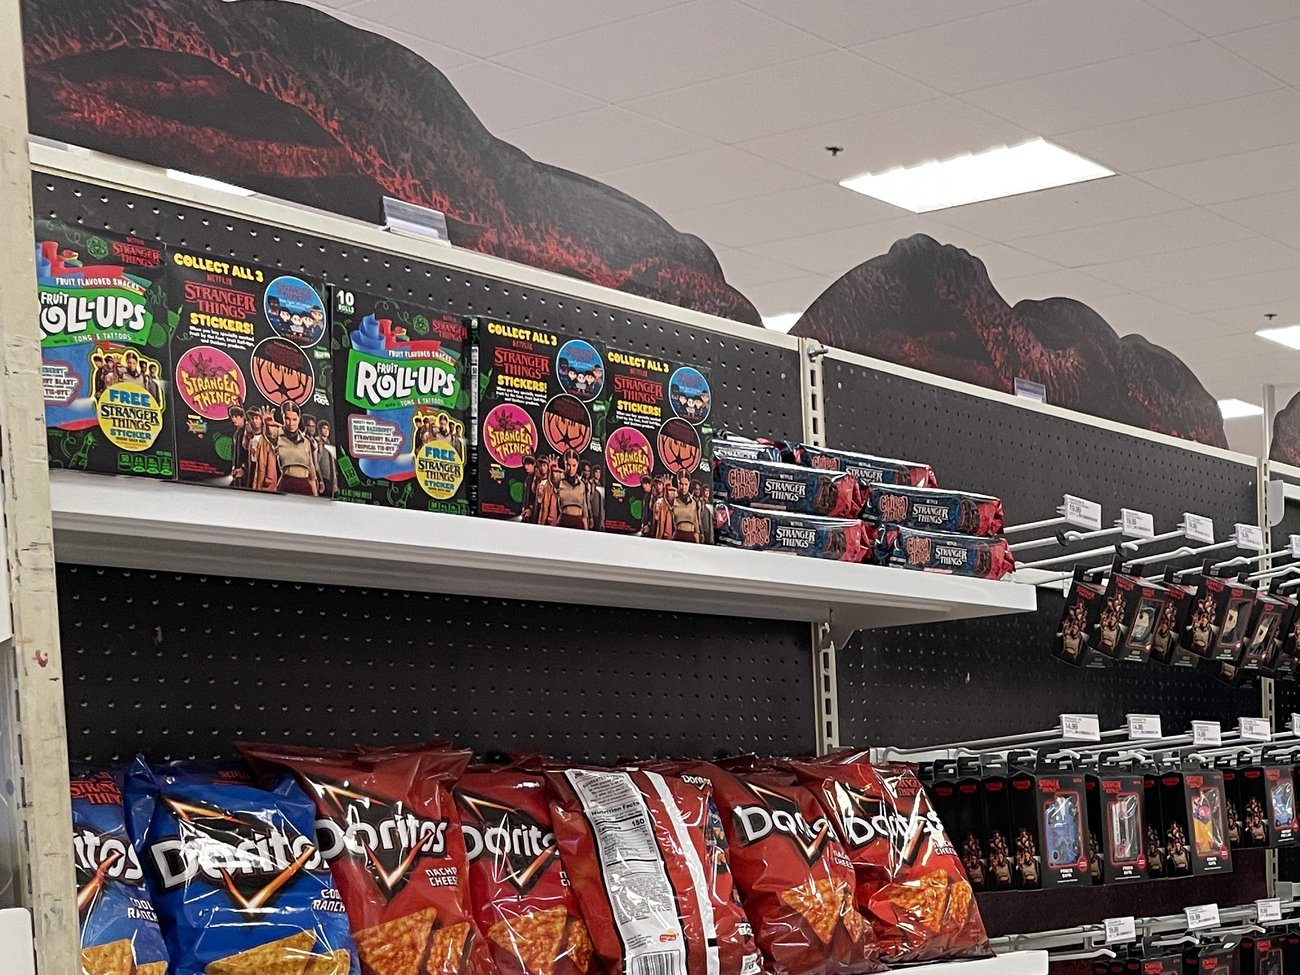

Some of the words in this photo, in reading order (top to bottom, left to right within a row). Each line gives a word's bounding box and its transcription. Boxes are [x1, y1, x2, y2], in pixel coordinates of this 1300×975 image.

[173, 253, 230, 275] COLLECT
[232, 266, 254, 281] ALL
[256, 270, 264, 283] 3
[56, 277, 75, 286] FRUIT
[78, 277, 112, 287] FLAVORED
[113, 277, 140, 291] SNACKS
[41, 292, 70, 305] FRUIT
[184, 282, 257, 314] STRANGER
[336, 290, 355, 306] 10
[197, 302, 246, 320] THINGS
[190, 313, 254, 335] STICKERS!
[488, 323, 531, 340] COLLECT
[533, 332, 549, 345] ALL
[551, 336, 558, 346] 3
[377, 362, 398, 374] FRUIT
[495, 348, 550, 374] STRANGER
[608, 352, 646, 369] COLLECT
[647, 361, 662, 373] ALL
[663, 363, 670, 373] 3
[503, 363, 541, 379] THINGS
[181, 369, 240, 396] STRANGER
[356, 361, 455, 404] ROLL-UPS
[498, 375, 547, 393] STICKERS!
[614, 375, 663, 399] STRANGER
[109, 389, 150, 407] FREE
[194, 391, 238, 410] THINGS
[623, 389, 656, 404] THINGS
[101, 403, 159, 426] STRANGER
[617, 400, 661, 417] STICKERS!
[111, 418, 151, 431] THINGS
[110, 429, 151, 440] STICKER
[425, 447, 456, 461] FREE
[419, 460, 460, 477] STRANGER
[426, 470, 455, 482] THINGS
[765, 480, 806, 496] STRANGER
[771, 490, 799, 502] THINGS
[912, 504, 949, 520] STRANGER
[917, 514, 943, 524] THINGS
[776, 527, 816, 542] STRANGER
[782, 537, 809, 548] THINGS
[935, 546, 967, 562] STRANGER
[87, 793, 122, 805] THIN
[591, 804, 622, 816] Nutrition
[632, 818, 645, 827] 150
[315, 814, 447, 860] Doritos
